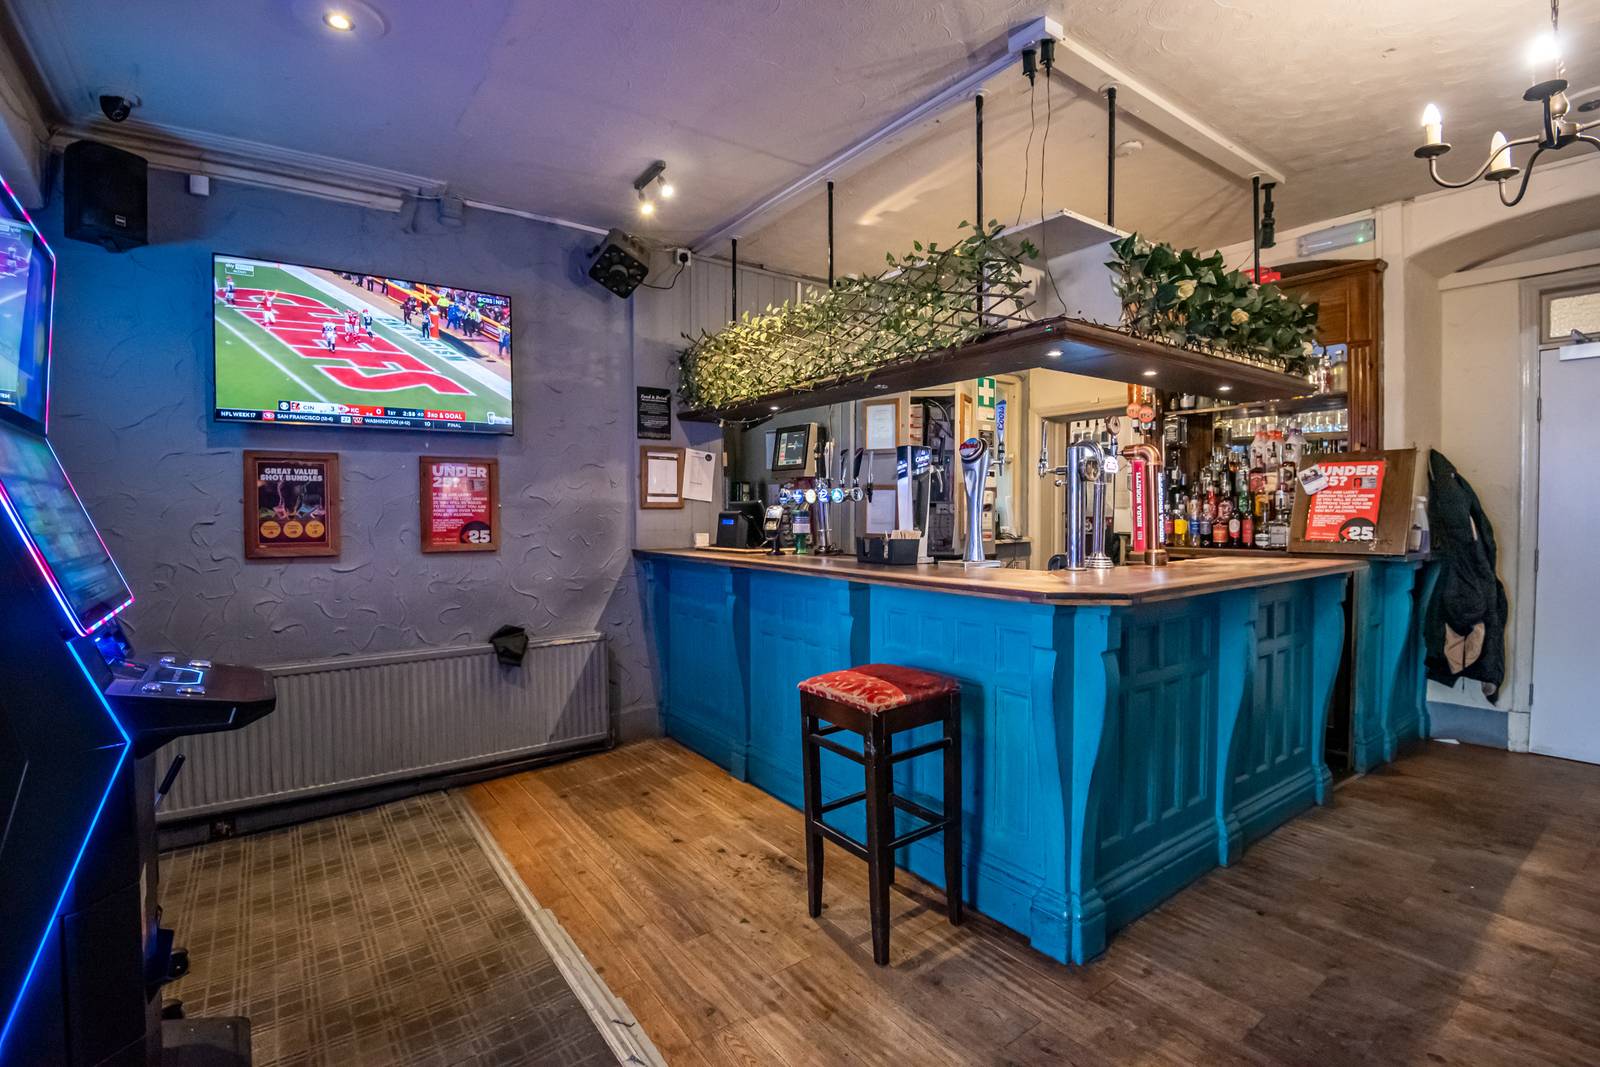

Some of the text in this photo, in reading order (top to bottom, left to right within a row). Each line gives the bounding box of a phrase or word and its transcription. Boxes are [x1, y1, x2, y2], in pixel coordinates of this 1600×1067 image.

[264, 467, 319, 476] GREAT VALUE
[432, 465, 488, 478] UNDER
[1322, 465, 1379, 476] UNDER
[285, 474, 323, 482] BUNDLES
[468, 529, 491, 544] 25
[1348, 526, 1374, 541] 25
